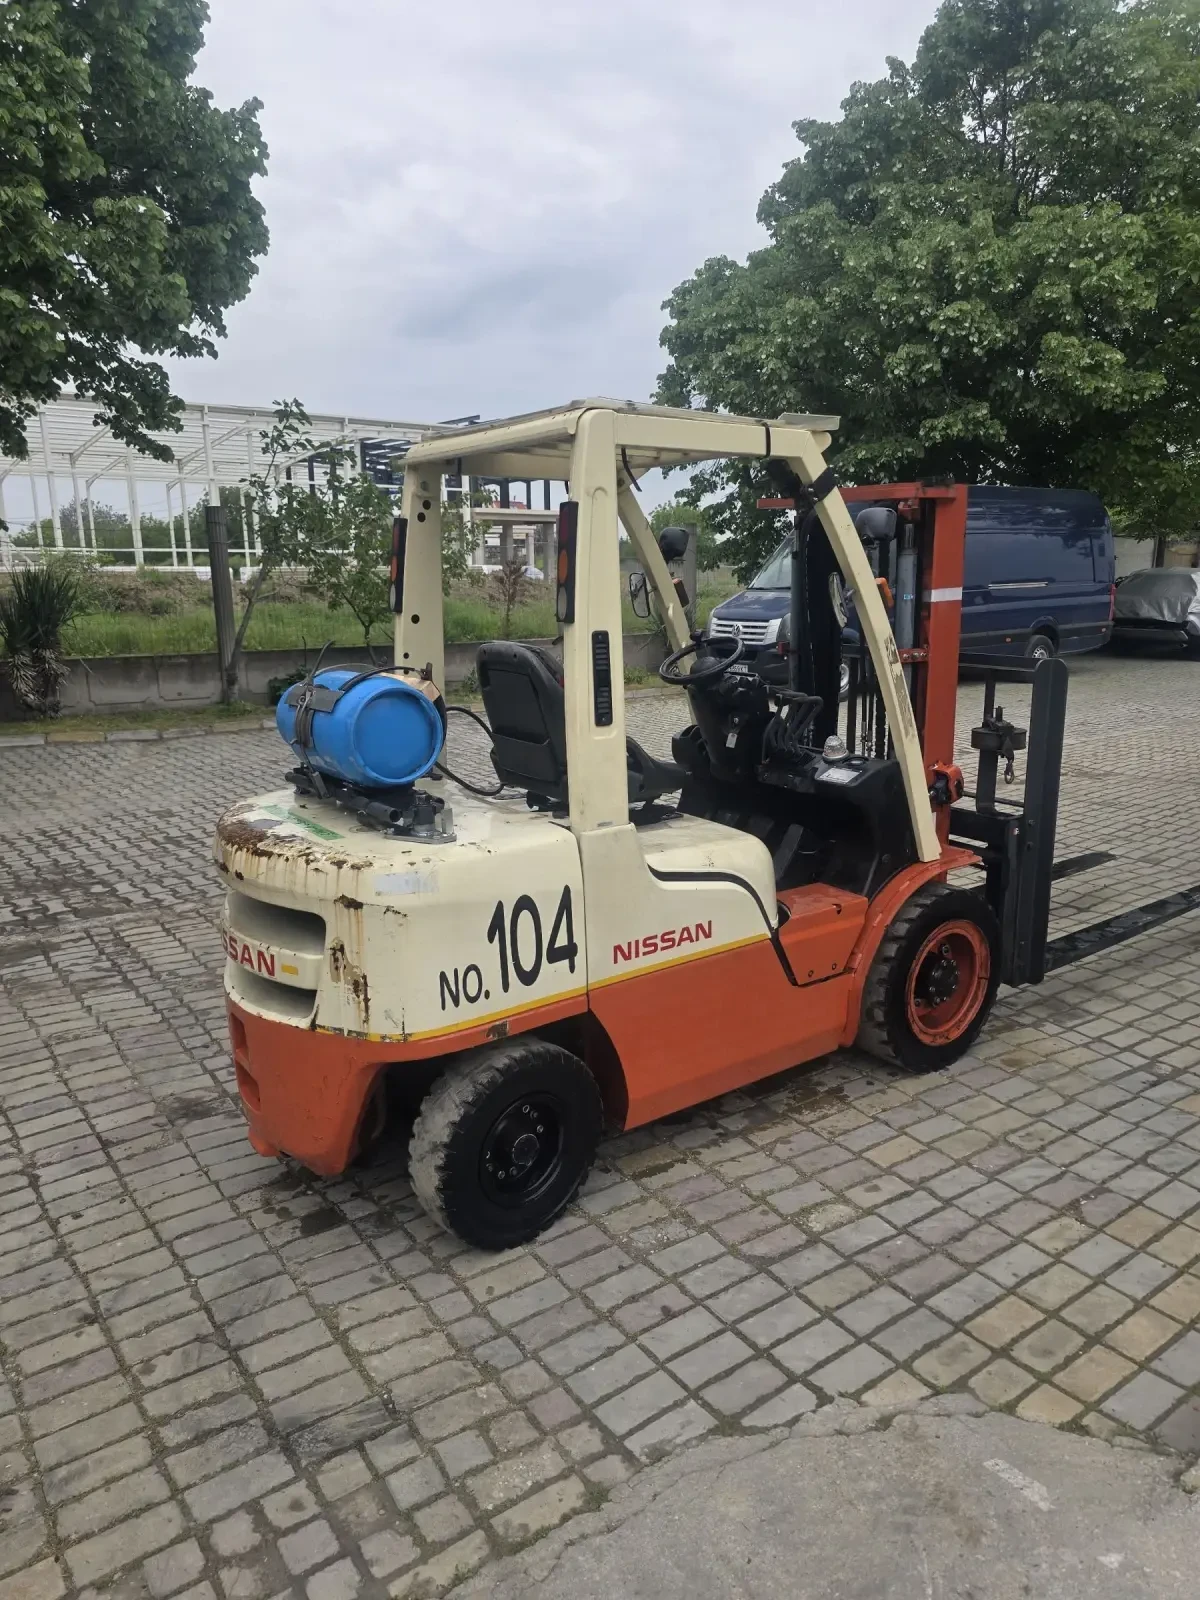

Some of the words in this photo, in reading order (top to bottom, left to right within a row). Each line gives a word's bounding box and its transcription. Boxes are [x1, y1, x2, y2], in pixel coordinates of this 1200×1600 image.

[222, 928, 276, 977] SSAN
[439, 963, 490, 1011] NO.
[487, 884, 579, 994] 104
[612, 920, 712, 964] NISSAN
